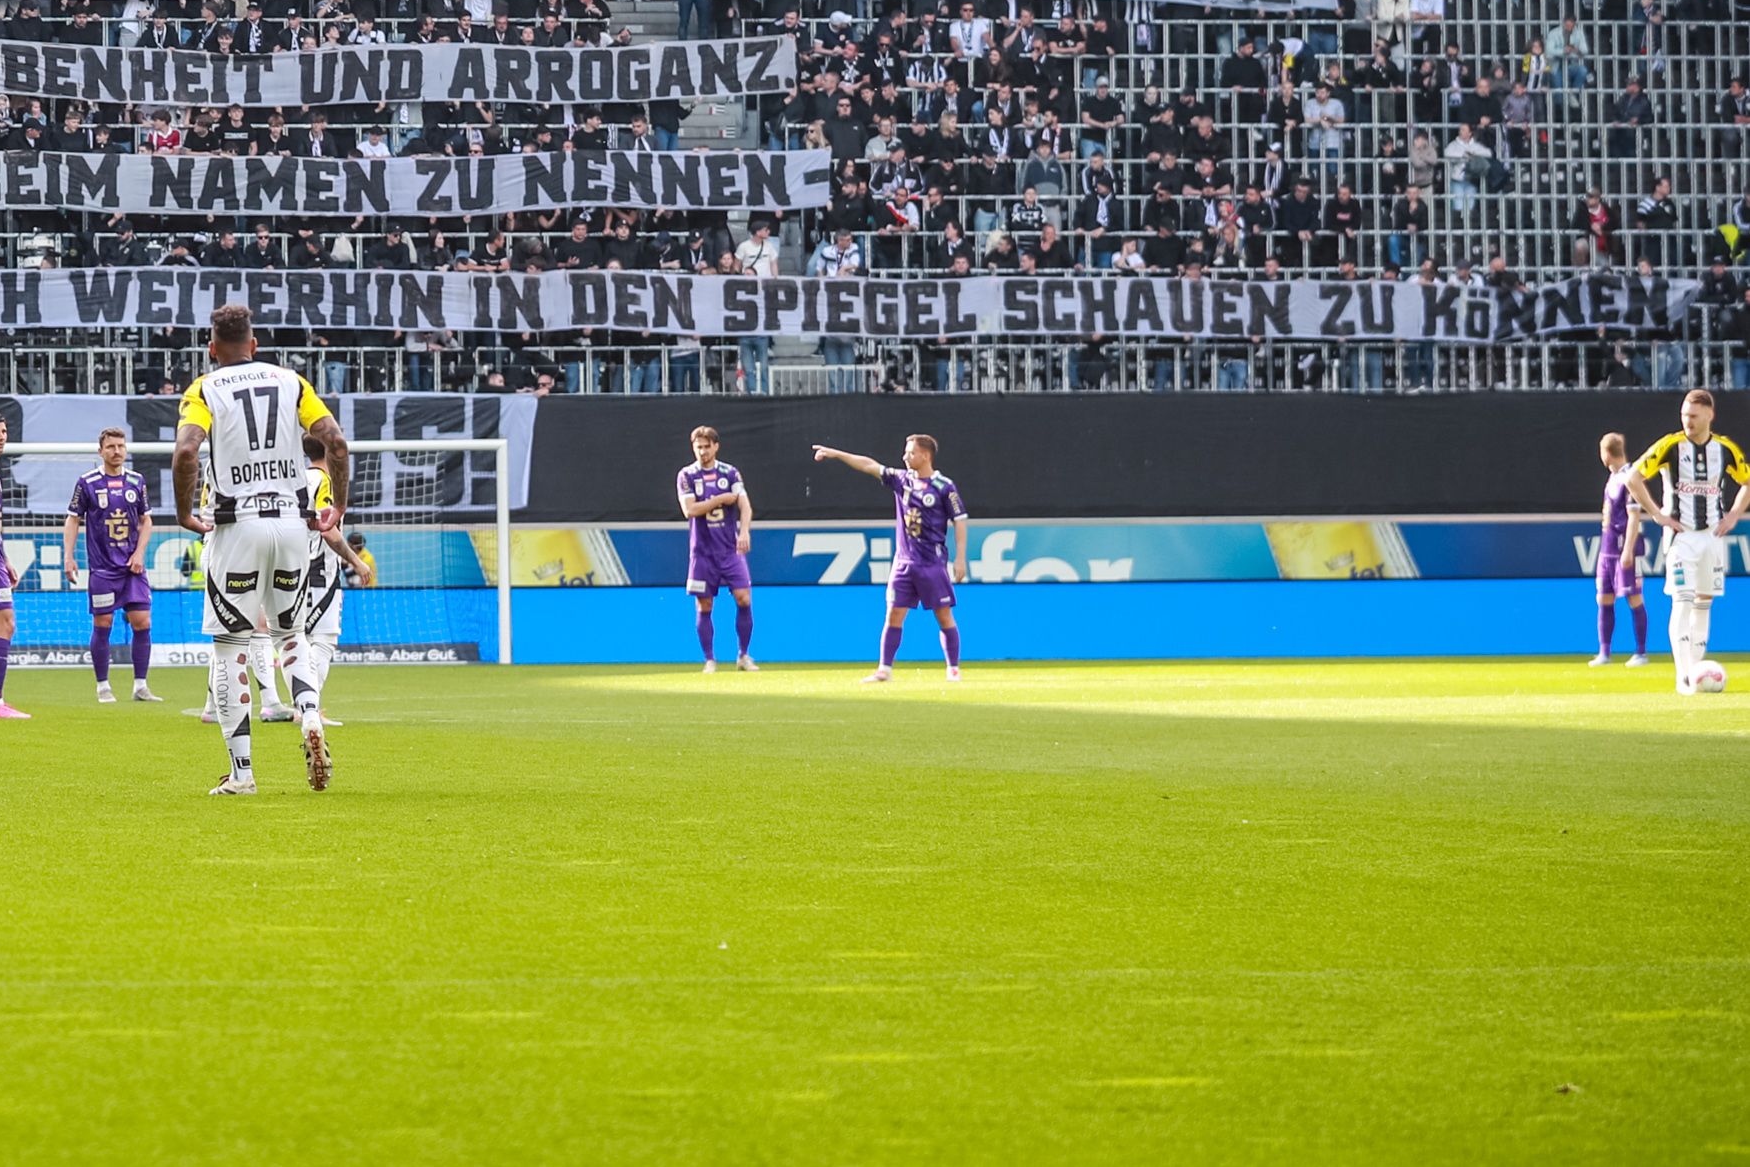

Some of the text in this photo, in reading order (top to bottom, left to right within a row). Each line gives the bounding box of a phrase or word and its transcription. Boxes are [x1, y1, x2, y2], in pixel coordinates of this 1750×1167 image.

[300, 44, 425, 102] UND
[449, 37, 795, 103] ARROGANZ.
[152, 155, 390, 214] NAMEN
[409, 156, 496, 213] ZU
[70, 270, 445, 330] WEITERHIN
[473, 274, 545, 328] IN
[570, 272, 696, 329] DEN
[723, 278, 977, 335] SPIEGEL
[1004, 279, 1292, 335] SCHAUEN
[1321, 285, 1394, 335] ZU
[233, 386, 279, 451] 17
[231, 459, 297, 485] BOATENG
[390, 649, 425, 662] Aber
